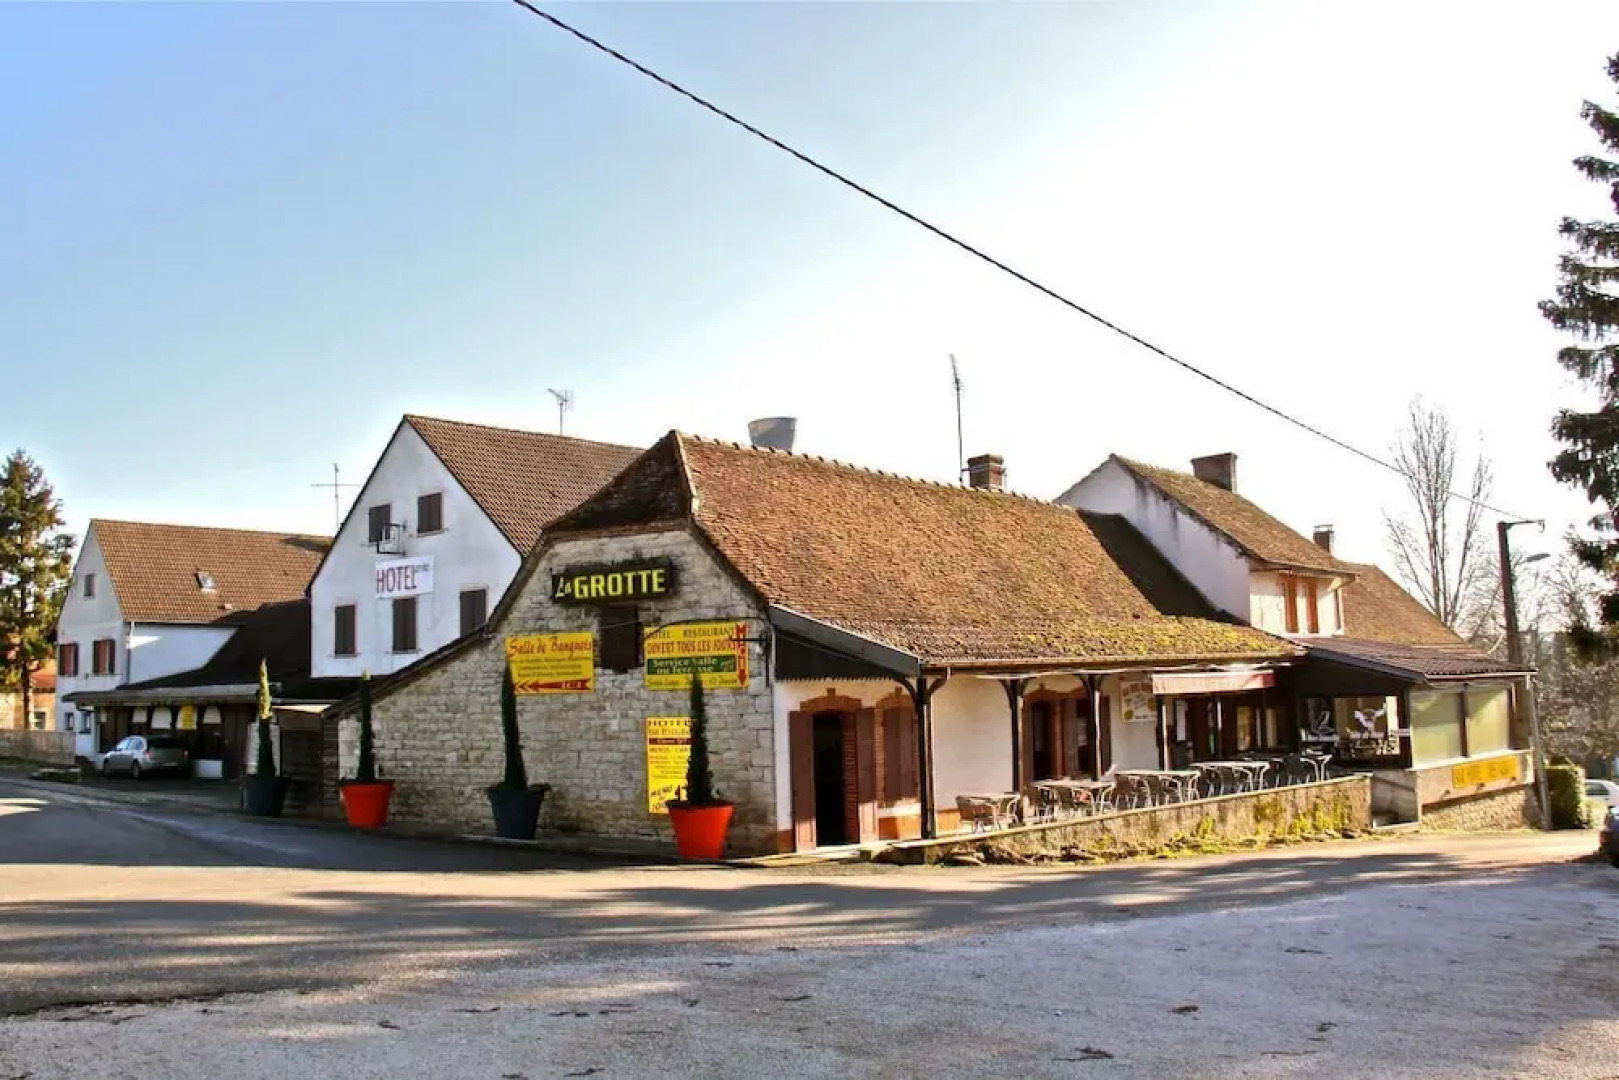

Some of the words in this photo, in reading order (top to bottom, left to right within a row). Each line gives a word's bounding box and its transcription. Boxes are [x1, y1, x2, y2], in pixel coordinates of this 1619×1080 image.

[376, 564, 417, 594] HOTEL
[555, 577, 572, 599] La
[574, 570, 666, 599] GROTTE
[683, 627, 735, 638] RESTAURANT
[508, 637, 534, 657] Salle
[551, 635, 591, 657] Banquets
[697, 640, 710, 652] LES
[654, 658, 690, 667] Service
